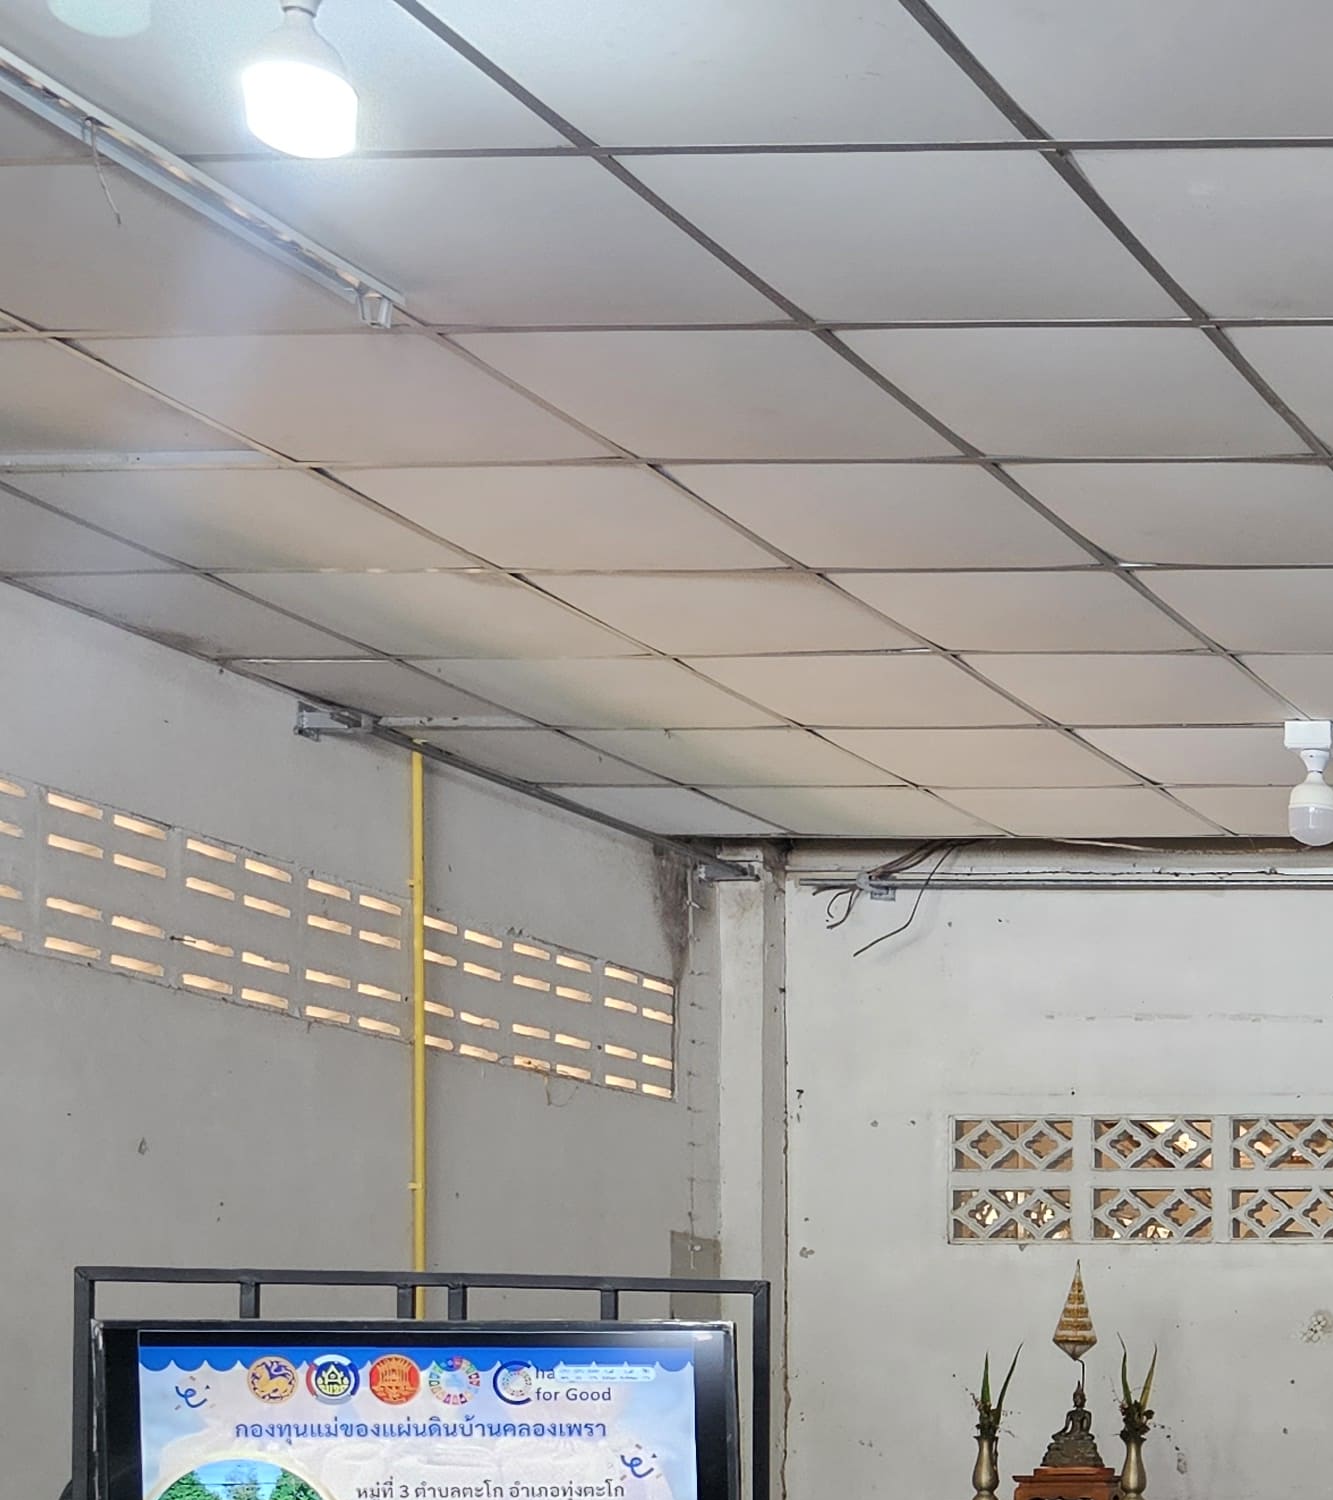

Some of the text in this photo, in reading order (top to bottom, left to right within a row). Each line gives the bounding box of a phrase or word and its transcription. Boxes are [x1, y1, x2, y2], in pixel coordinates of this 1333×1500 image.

[536, 1388, 611, 1401] for Good
[234, 1417, 607, 1442] กองทุนแม่ของแผ่นดินบ้านคลองเพรา
[399, 1485, 410, 1498] 3
[415, 1480, 503, 1499] ตำบลตะโก
